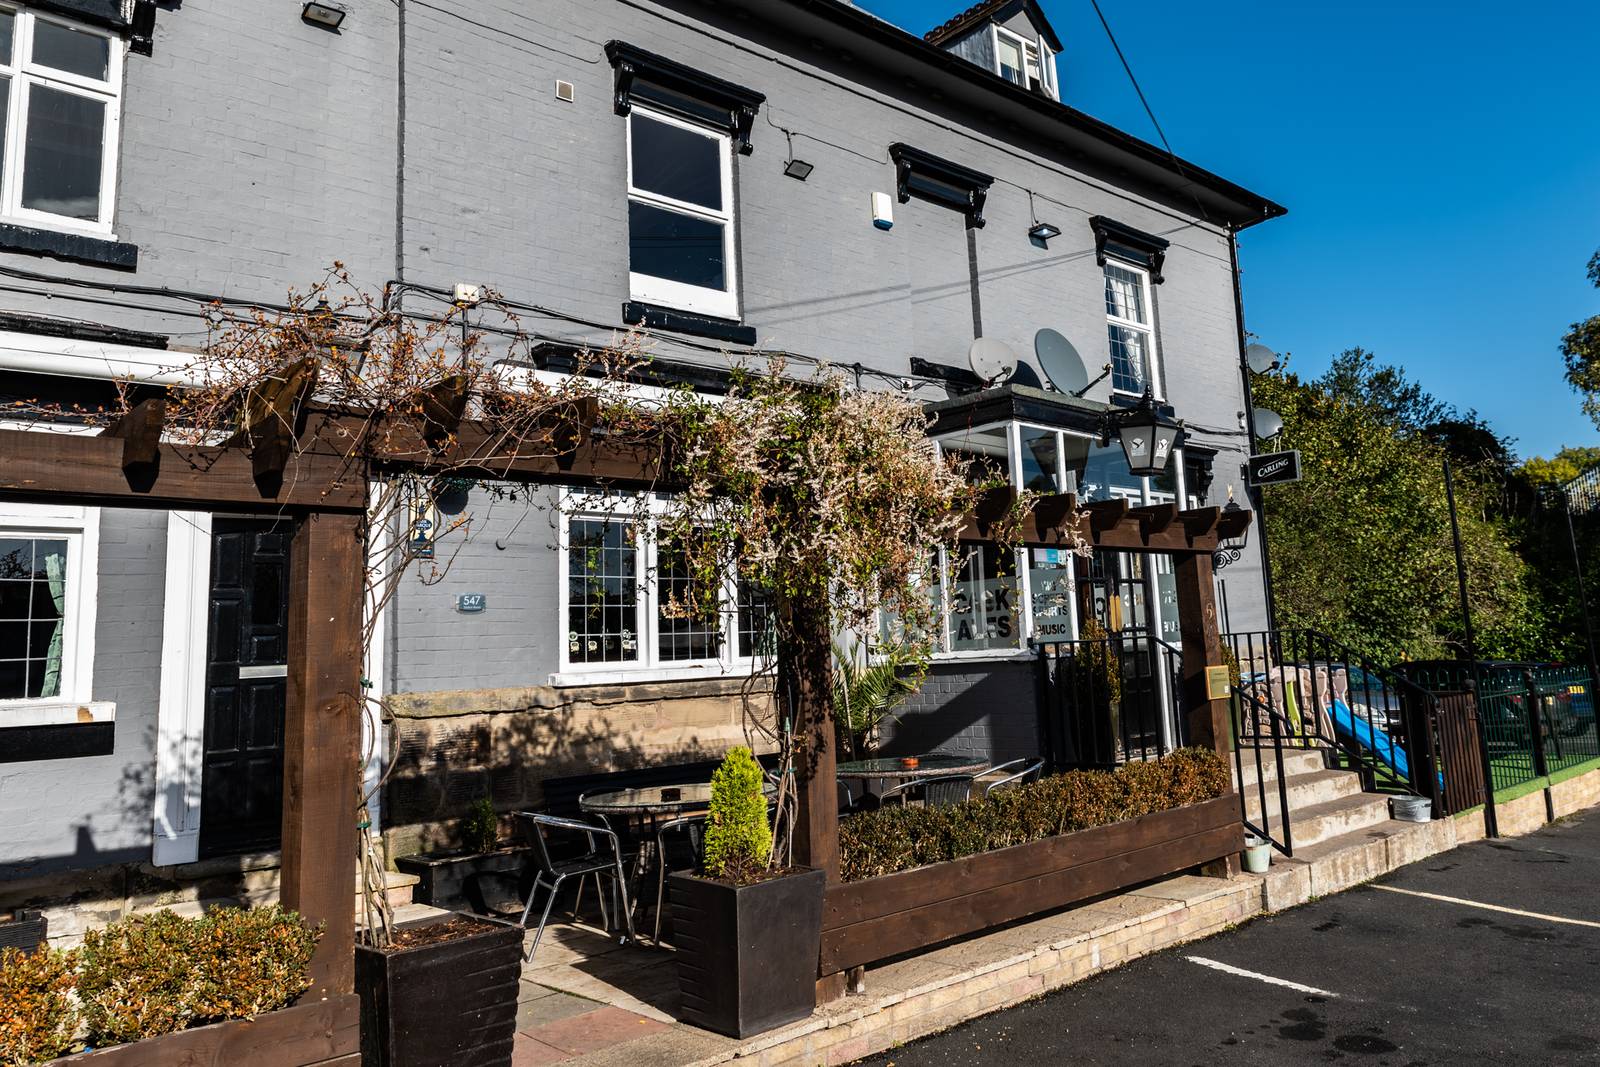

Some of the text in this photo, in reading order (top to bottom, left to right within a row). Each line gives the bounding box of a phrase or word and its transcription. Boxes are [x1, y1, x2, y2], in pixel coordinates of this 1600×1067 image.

[1257, 458, 1289, 477] CARLING
[463, 595, 481, 605] 547
[1038, 623, 1067, 635] MUSIC
